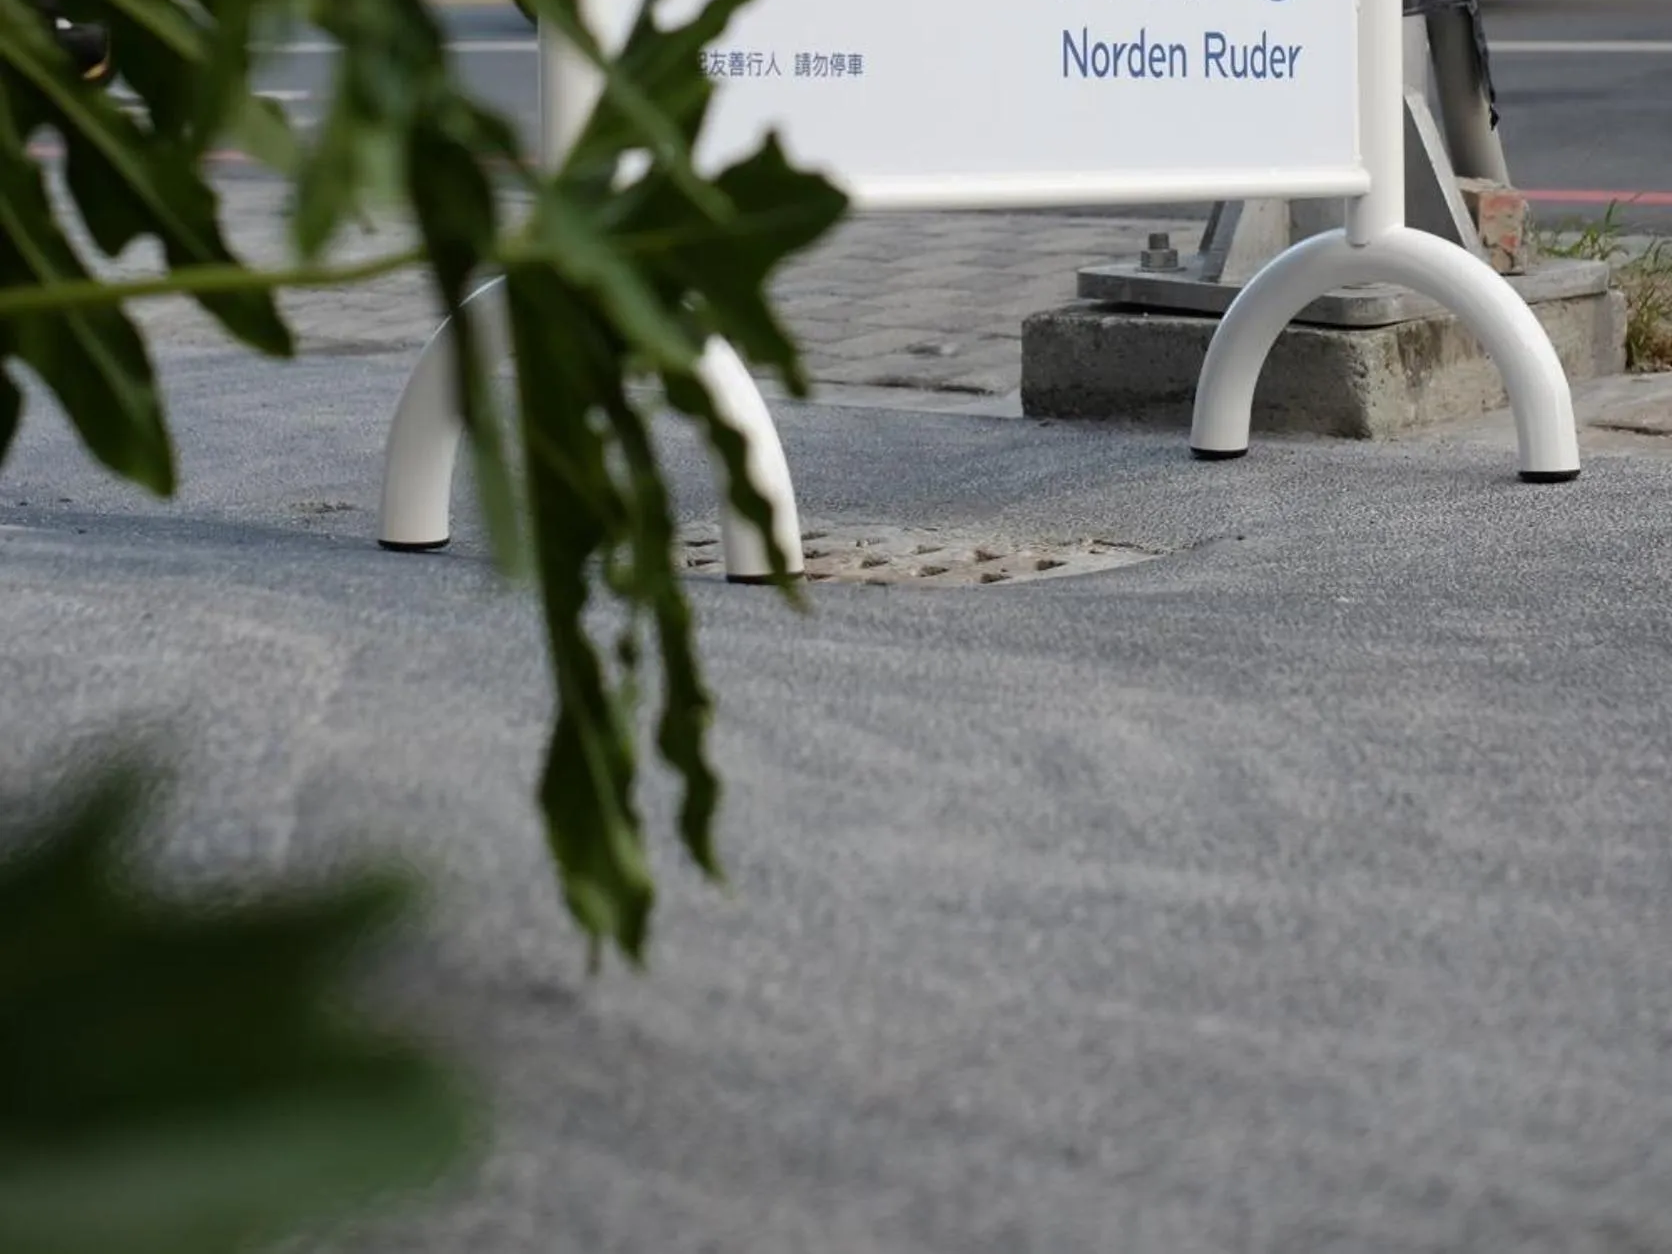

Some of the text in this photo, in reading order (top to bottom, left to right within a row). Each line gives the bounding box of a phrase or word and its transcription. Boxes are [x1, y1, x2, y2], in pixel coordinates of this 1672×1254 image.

[794, 51, 864, 77] 請勿停車
[1062, 27, 1302, 79] Norden Ruder
